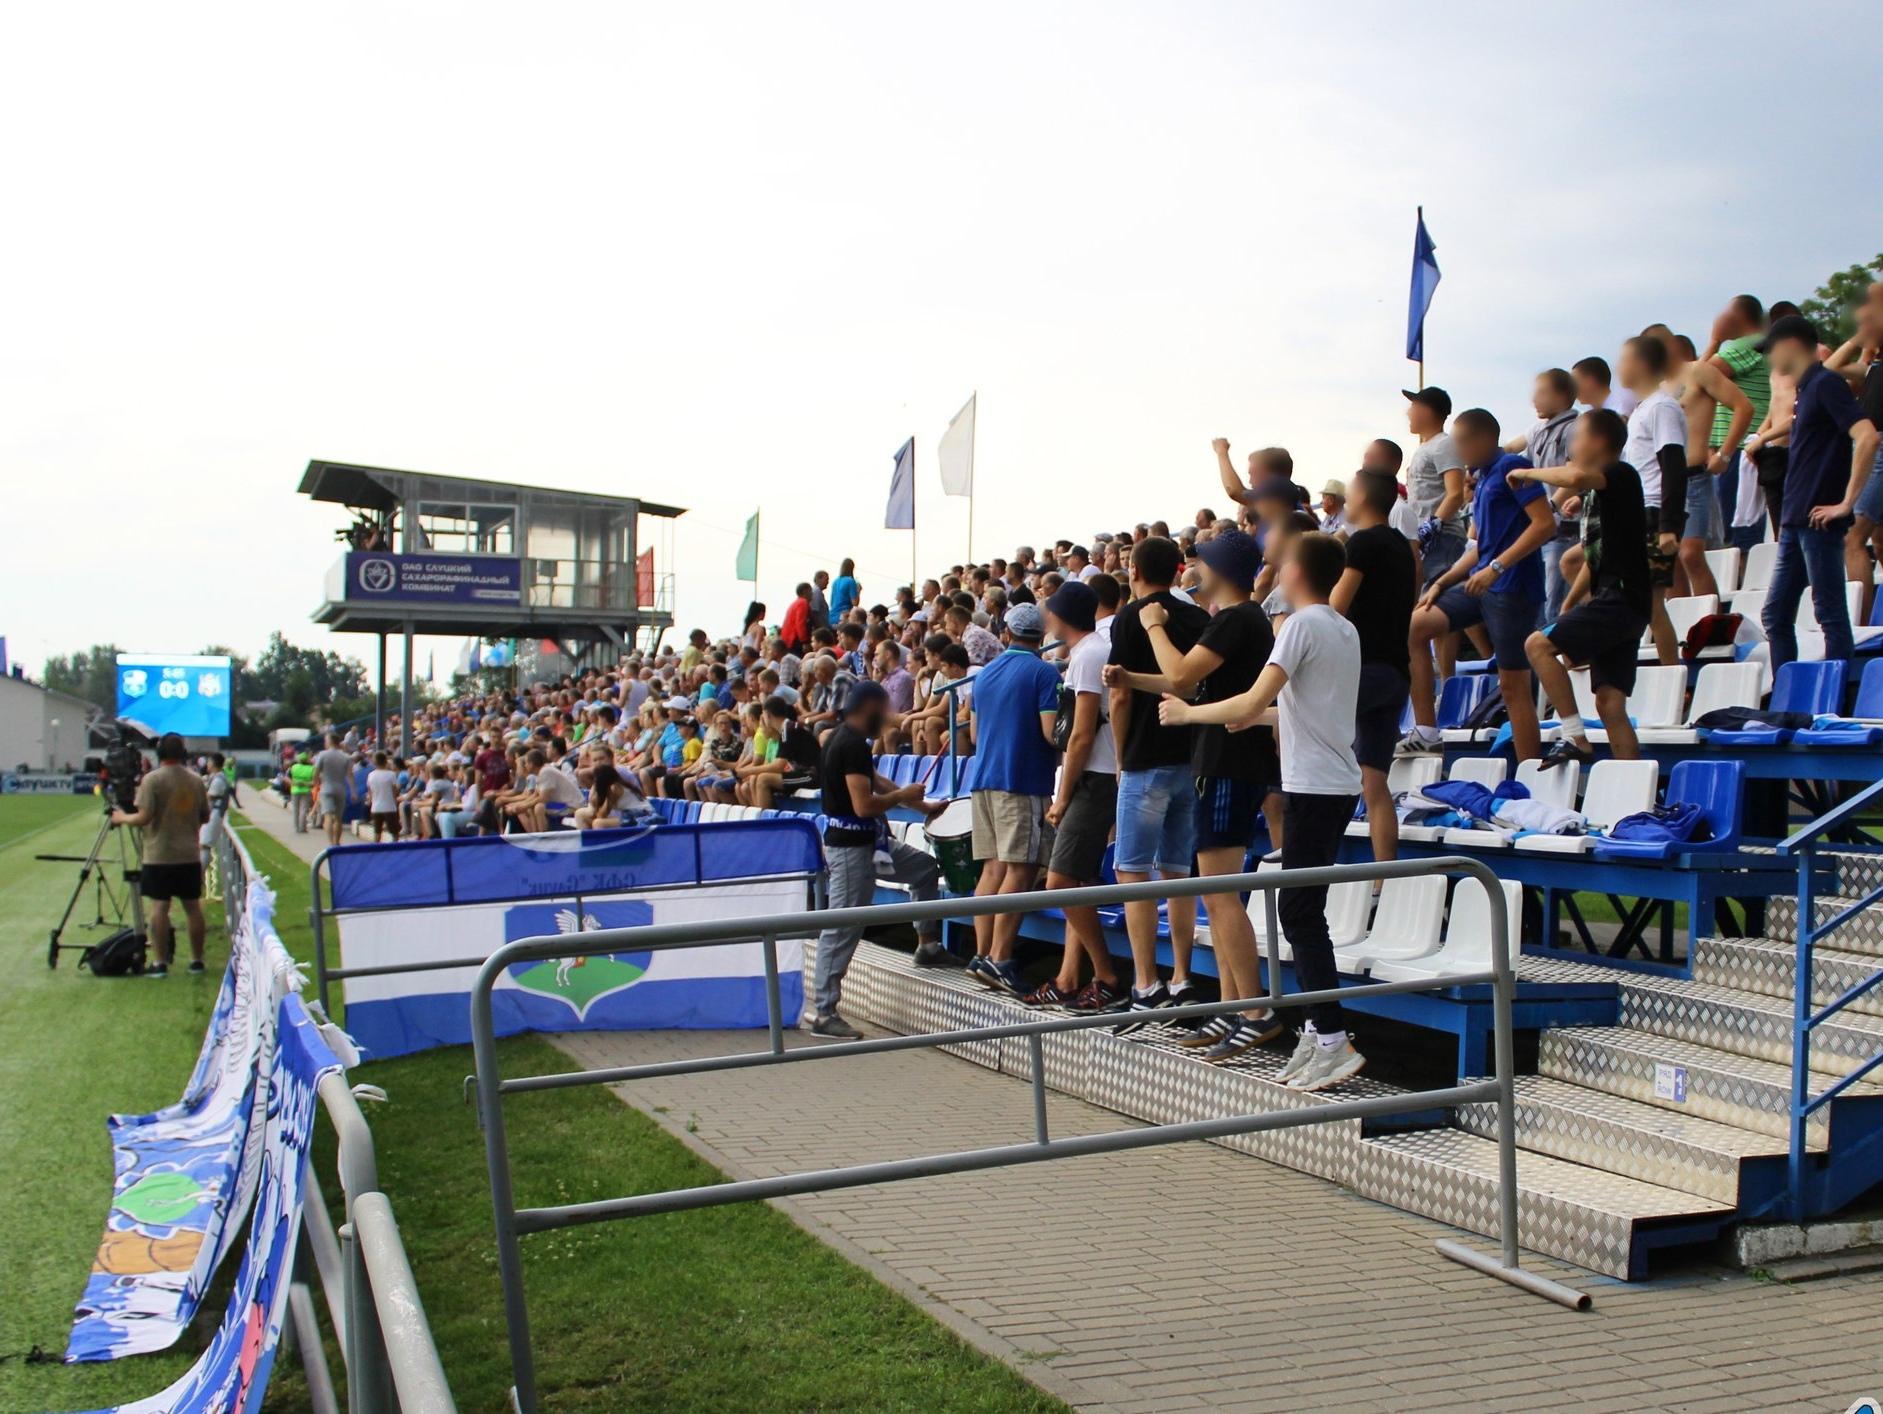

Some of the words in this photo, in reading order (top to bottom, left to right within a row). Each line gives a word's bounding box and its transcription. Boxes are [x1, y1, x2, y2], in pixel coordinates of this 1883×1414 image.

[401, 563, 422, 571] ОАО
[425, 563, 472, 573] СЛУЦКИЙ
[401, 583, 456, 593] КОМБИНАТ
[1675, 1074, 1683, 1096] 1
